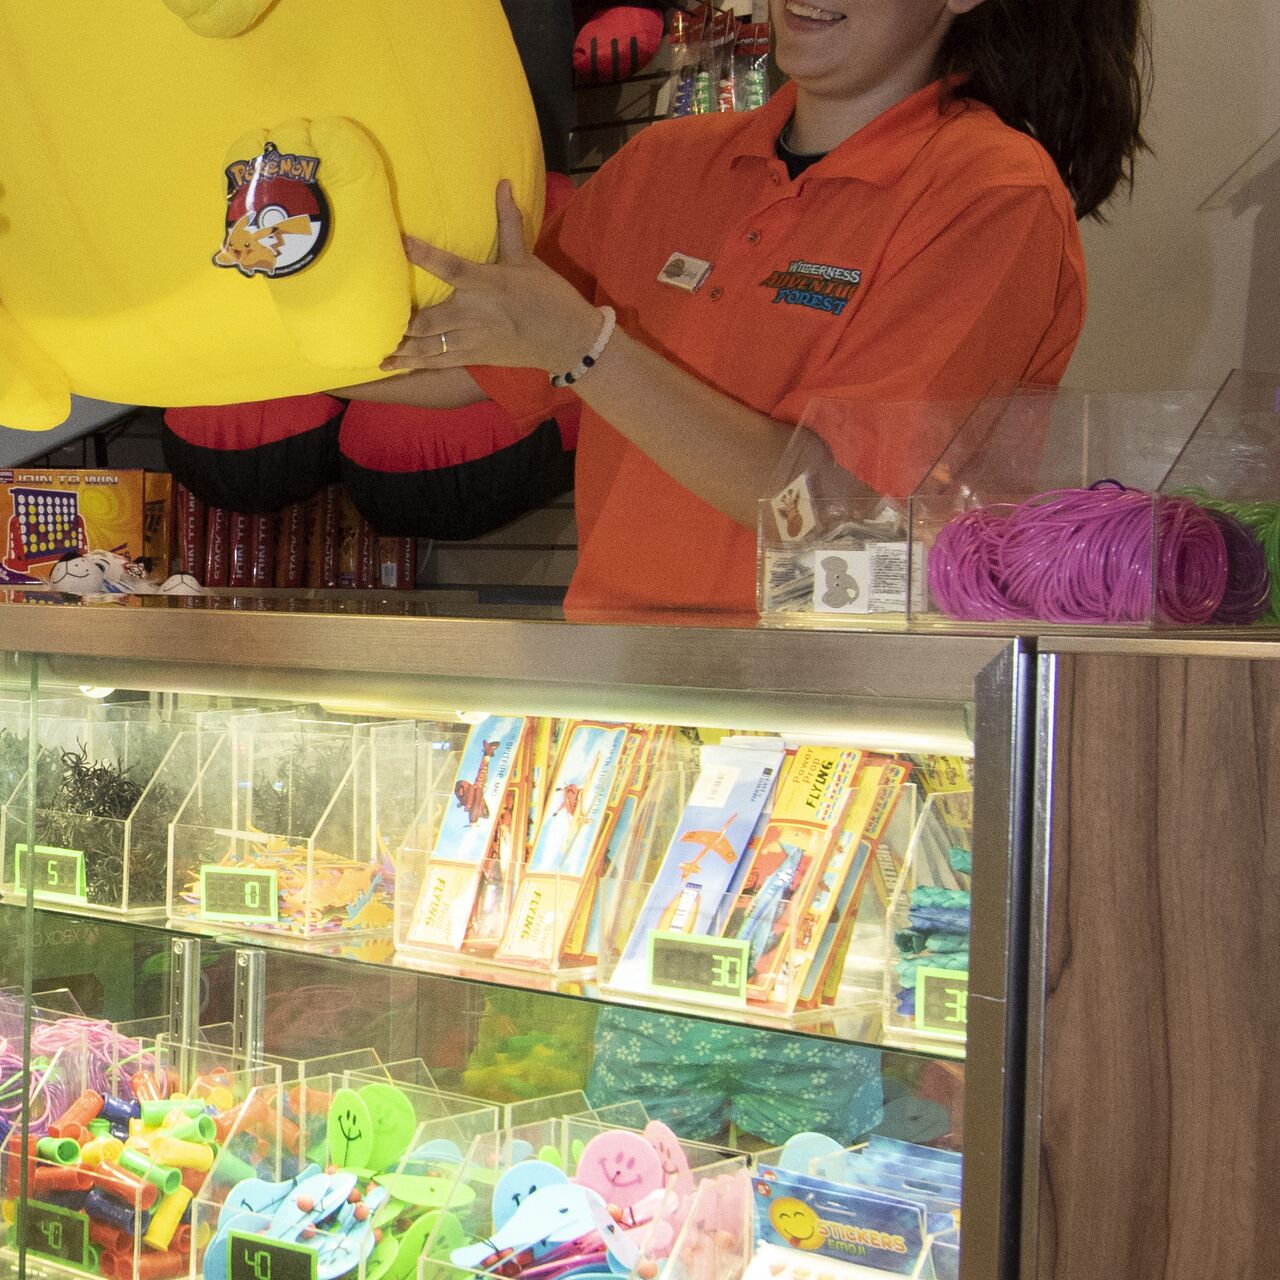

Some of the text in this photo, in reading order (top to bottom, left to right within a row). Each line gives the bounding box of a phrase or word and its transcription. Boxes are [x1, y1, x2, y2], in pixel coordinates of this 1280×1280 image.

[788, 260, 862, 283] WILDERNESS
[773, 288, 849, 316] FOREST
[801, 757, 822, 785] Prop
[805, 759, 834, 809] FLYING
[48, 860, 59, 885] 5
[425, 877, 447, 927] FLYING
[520, 890, 543, 939] FLYING
[711, 954, 742, 989] 30
[40, 1220, 63, 1250] 40
[818, 1218, 908, 1254] STICKERS
